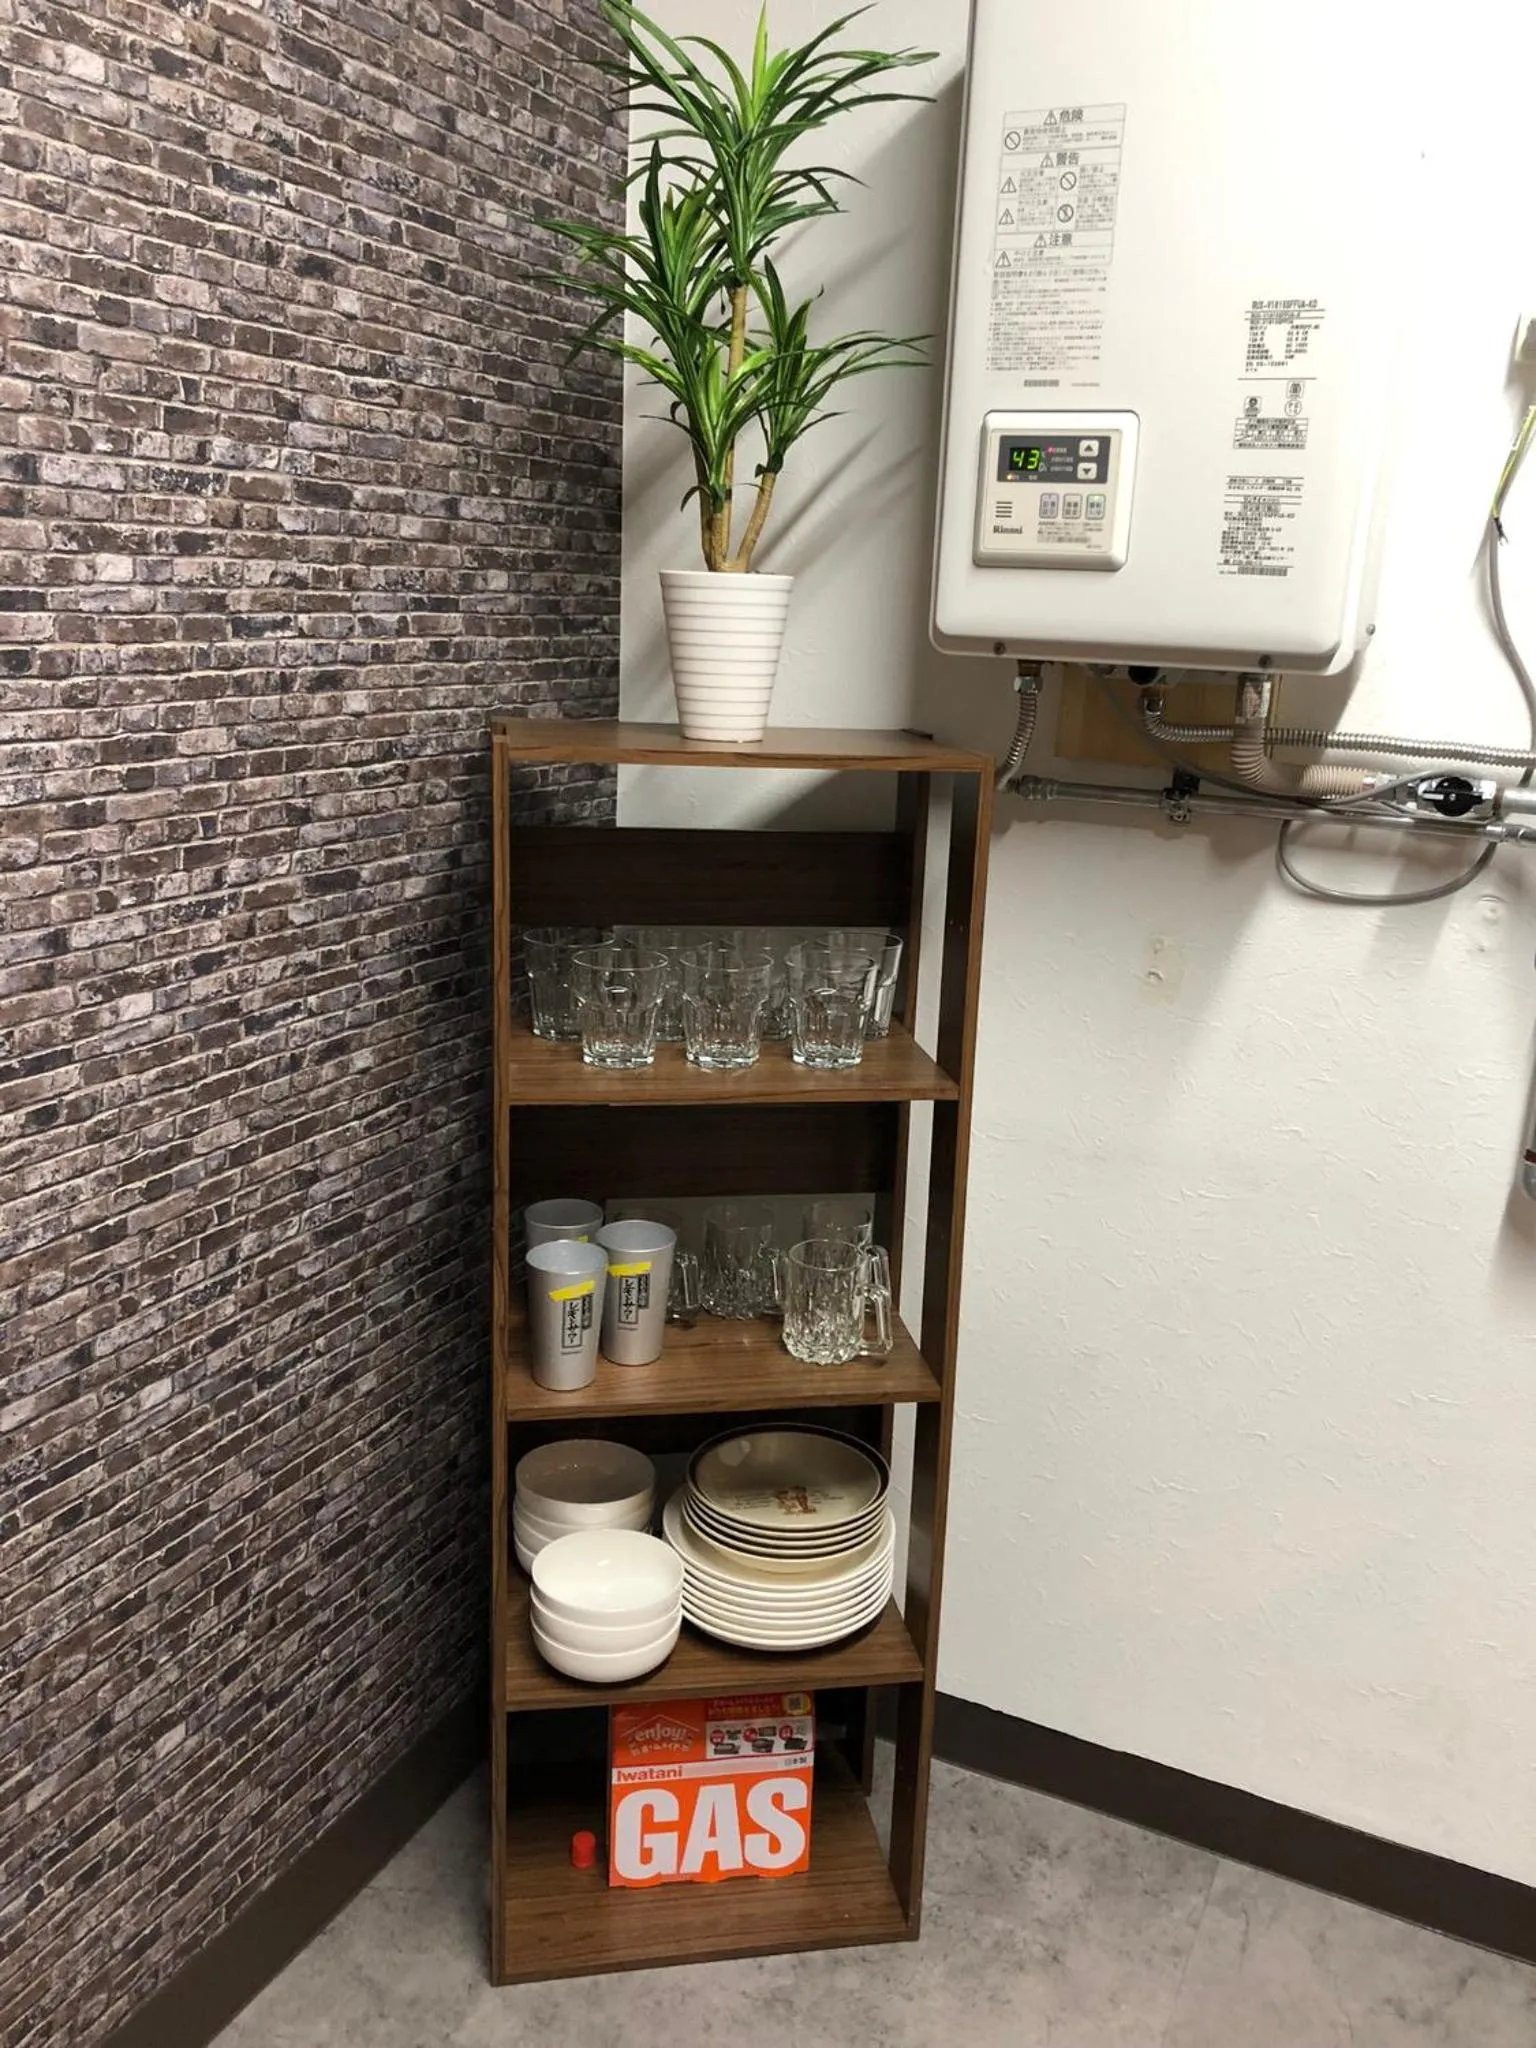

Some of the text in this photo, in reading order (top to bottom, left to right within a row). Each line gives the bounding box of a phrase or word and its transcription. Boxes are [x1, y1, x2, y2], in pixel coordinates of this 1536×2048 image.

[1013, 449, 1040, 469] 43
[993, 525, 1023, 535] Rinnai
[616, 1765, 683, 1782] Iwatani
[614, 1777, 808, 1880] GAS
